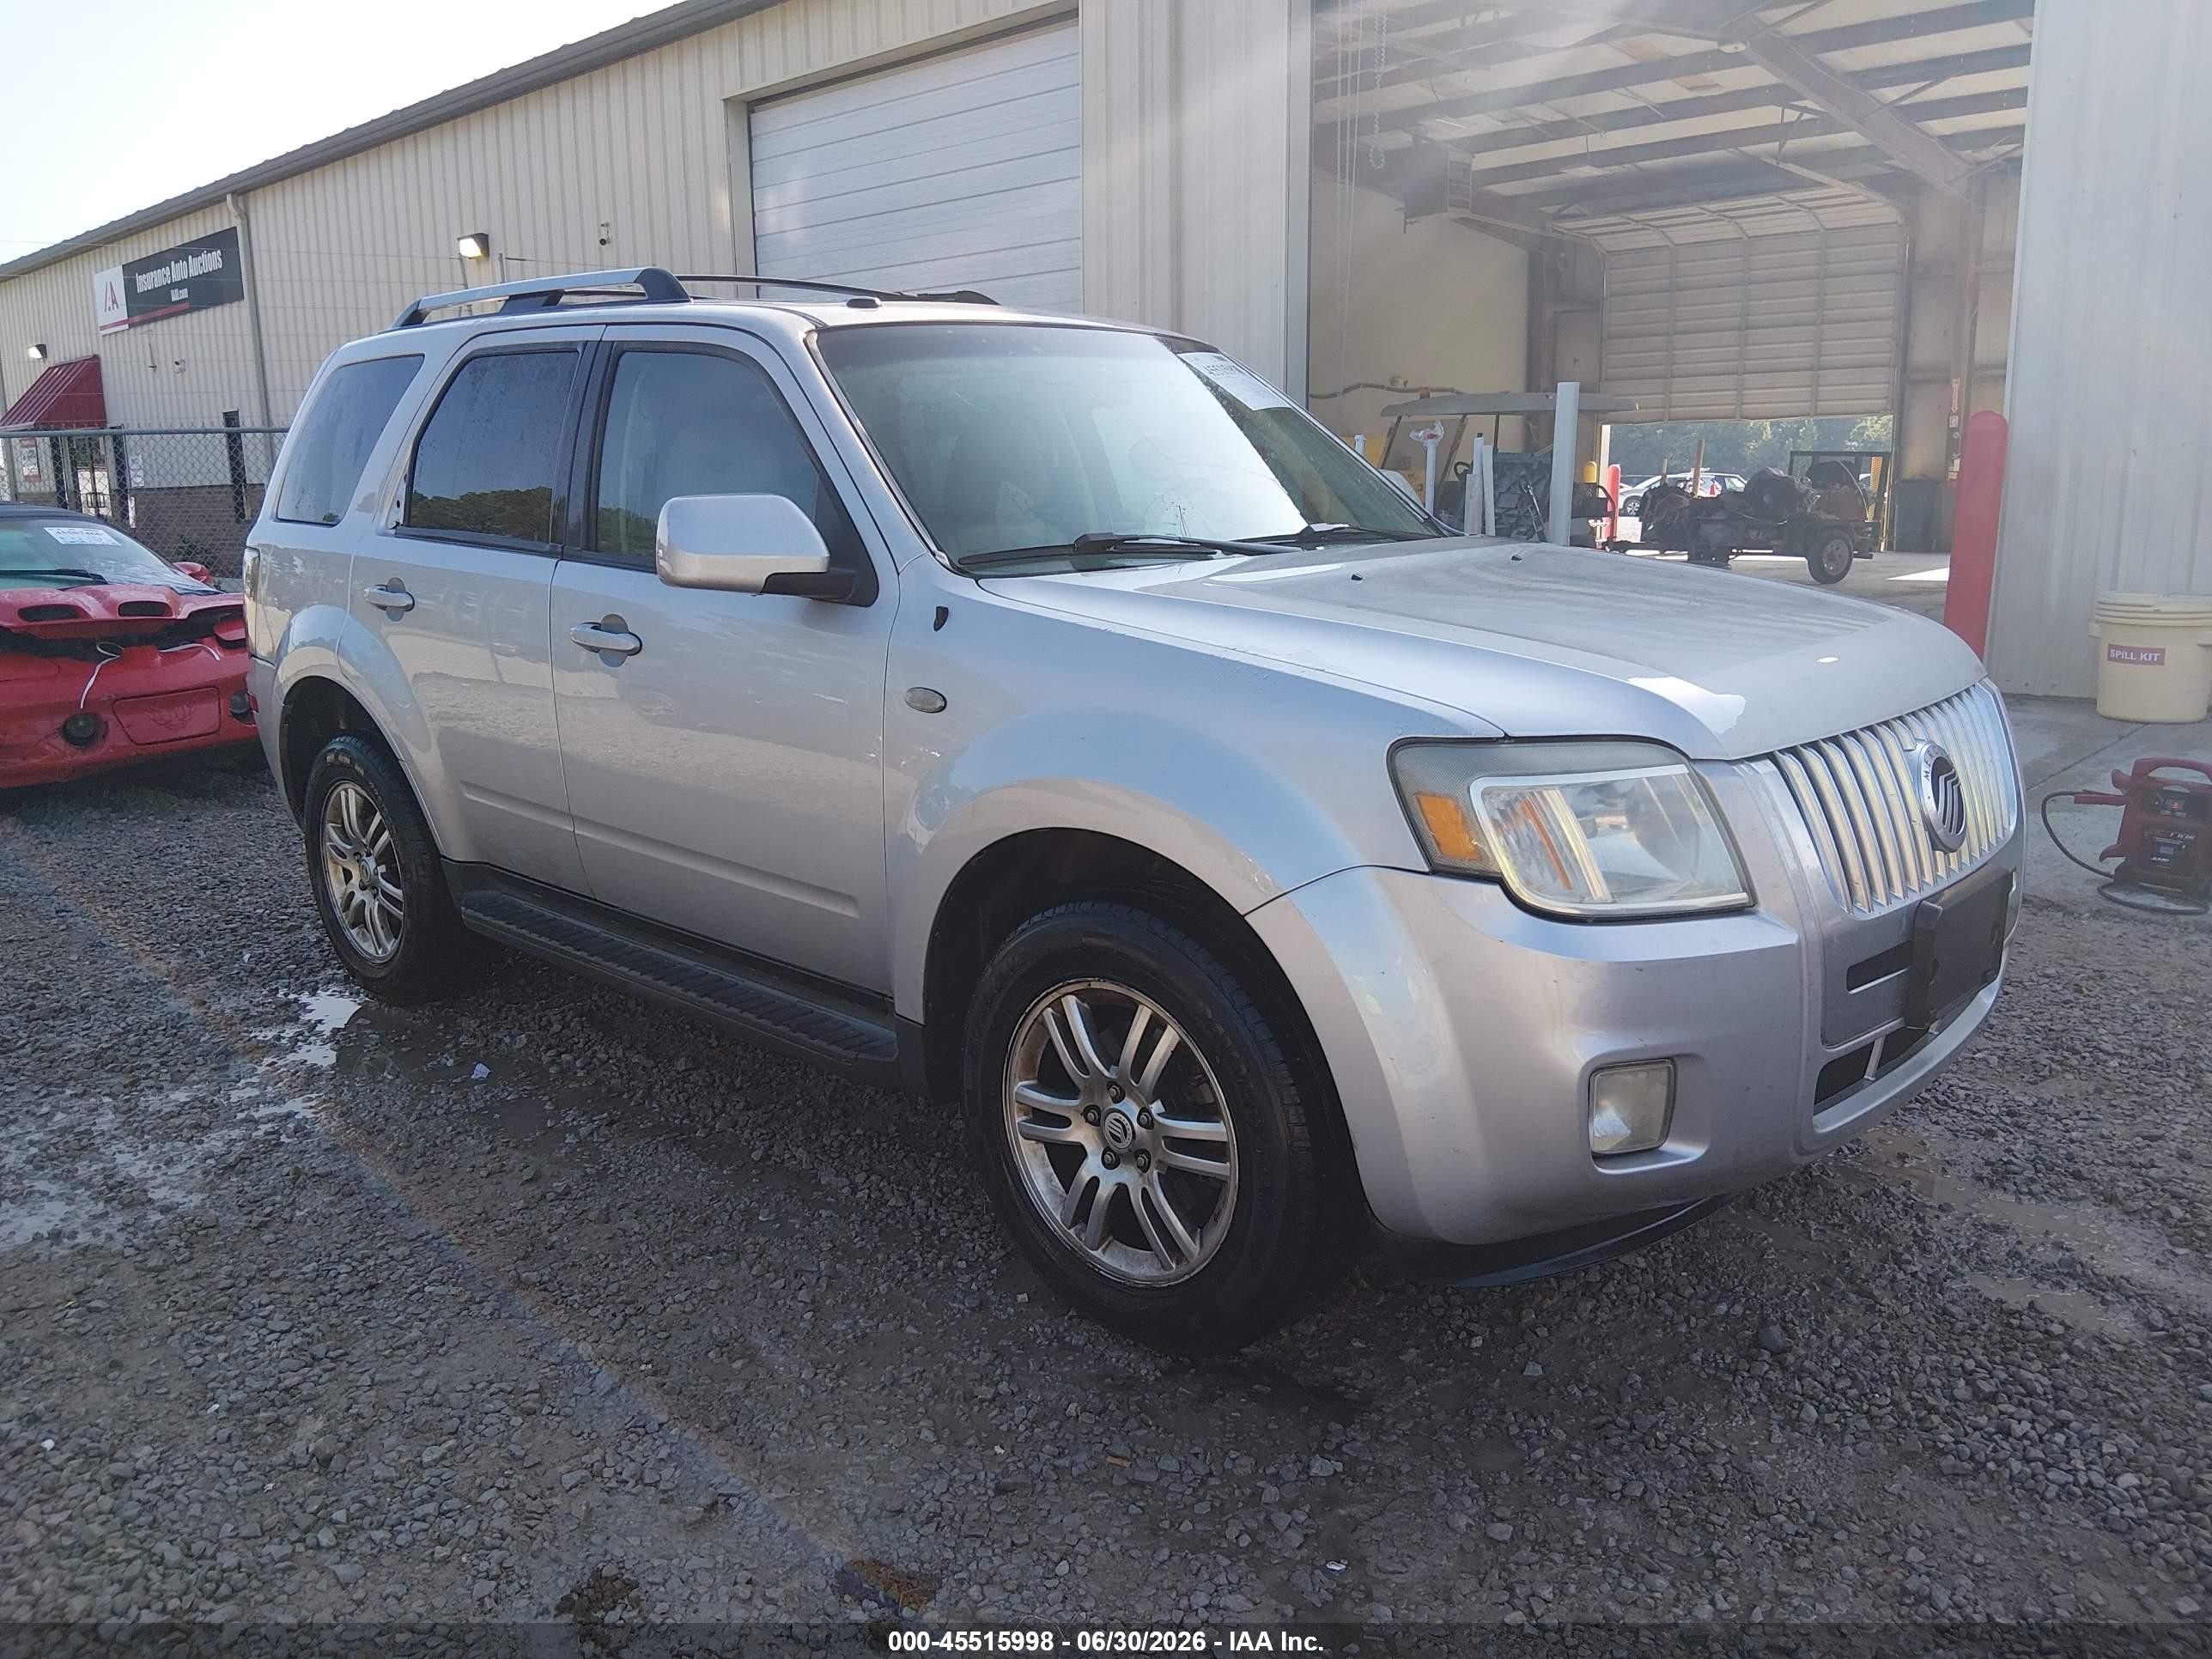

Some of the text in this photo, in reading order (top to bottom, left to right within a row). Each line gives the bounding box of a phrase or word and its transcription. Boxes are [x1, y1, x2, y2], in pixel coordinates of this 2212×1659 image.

[136, 249, 223, 294] Insurance Auto Auctions
[2110, 648, 2160, 661] SPILL KIT
